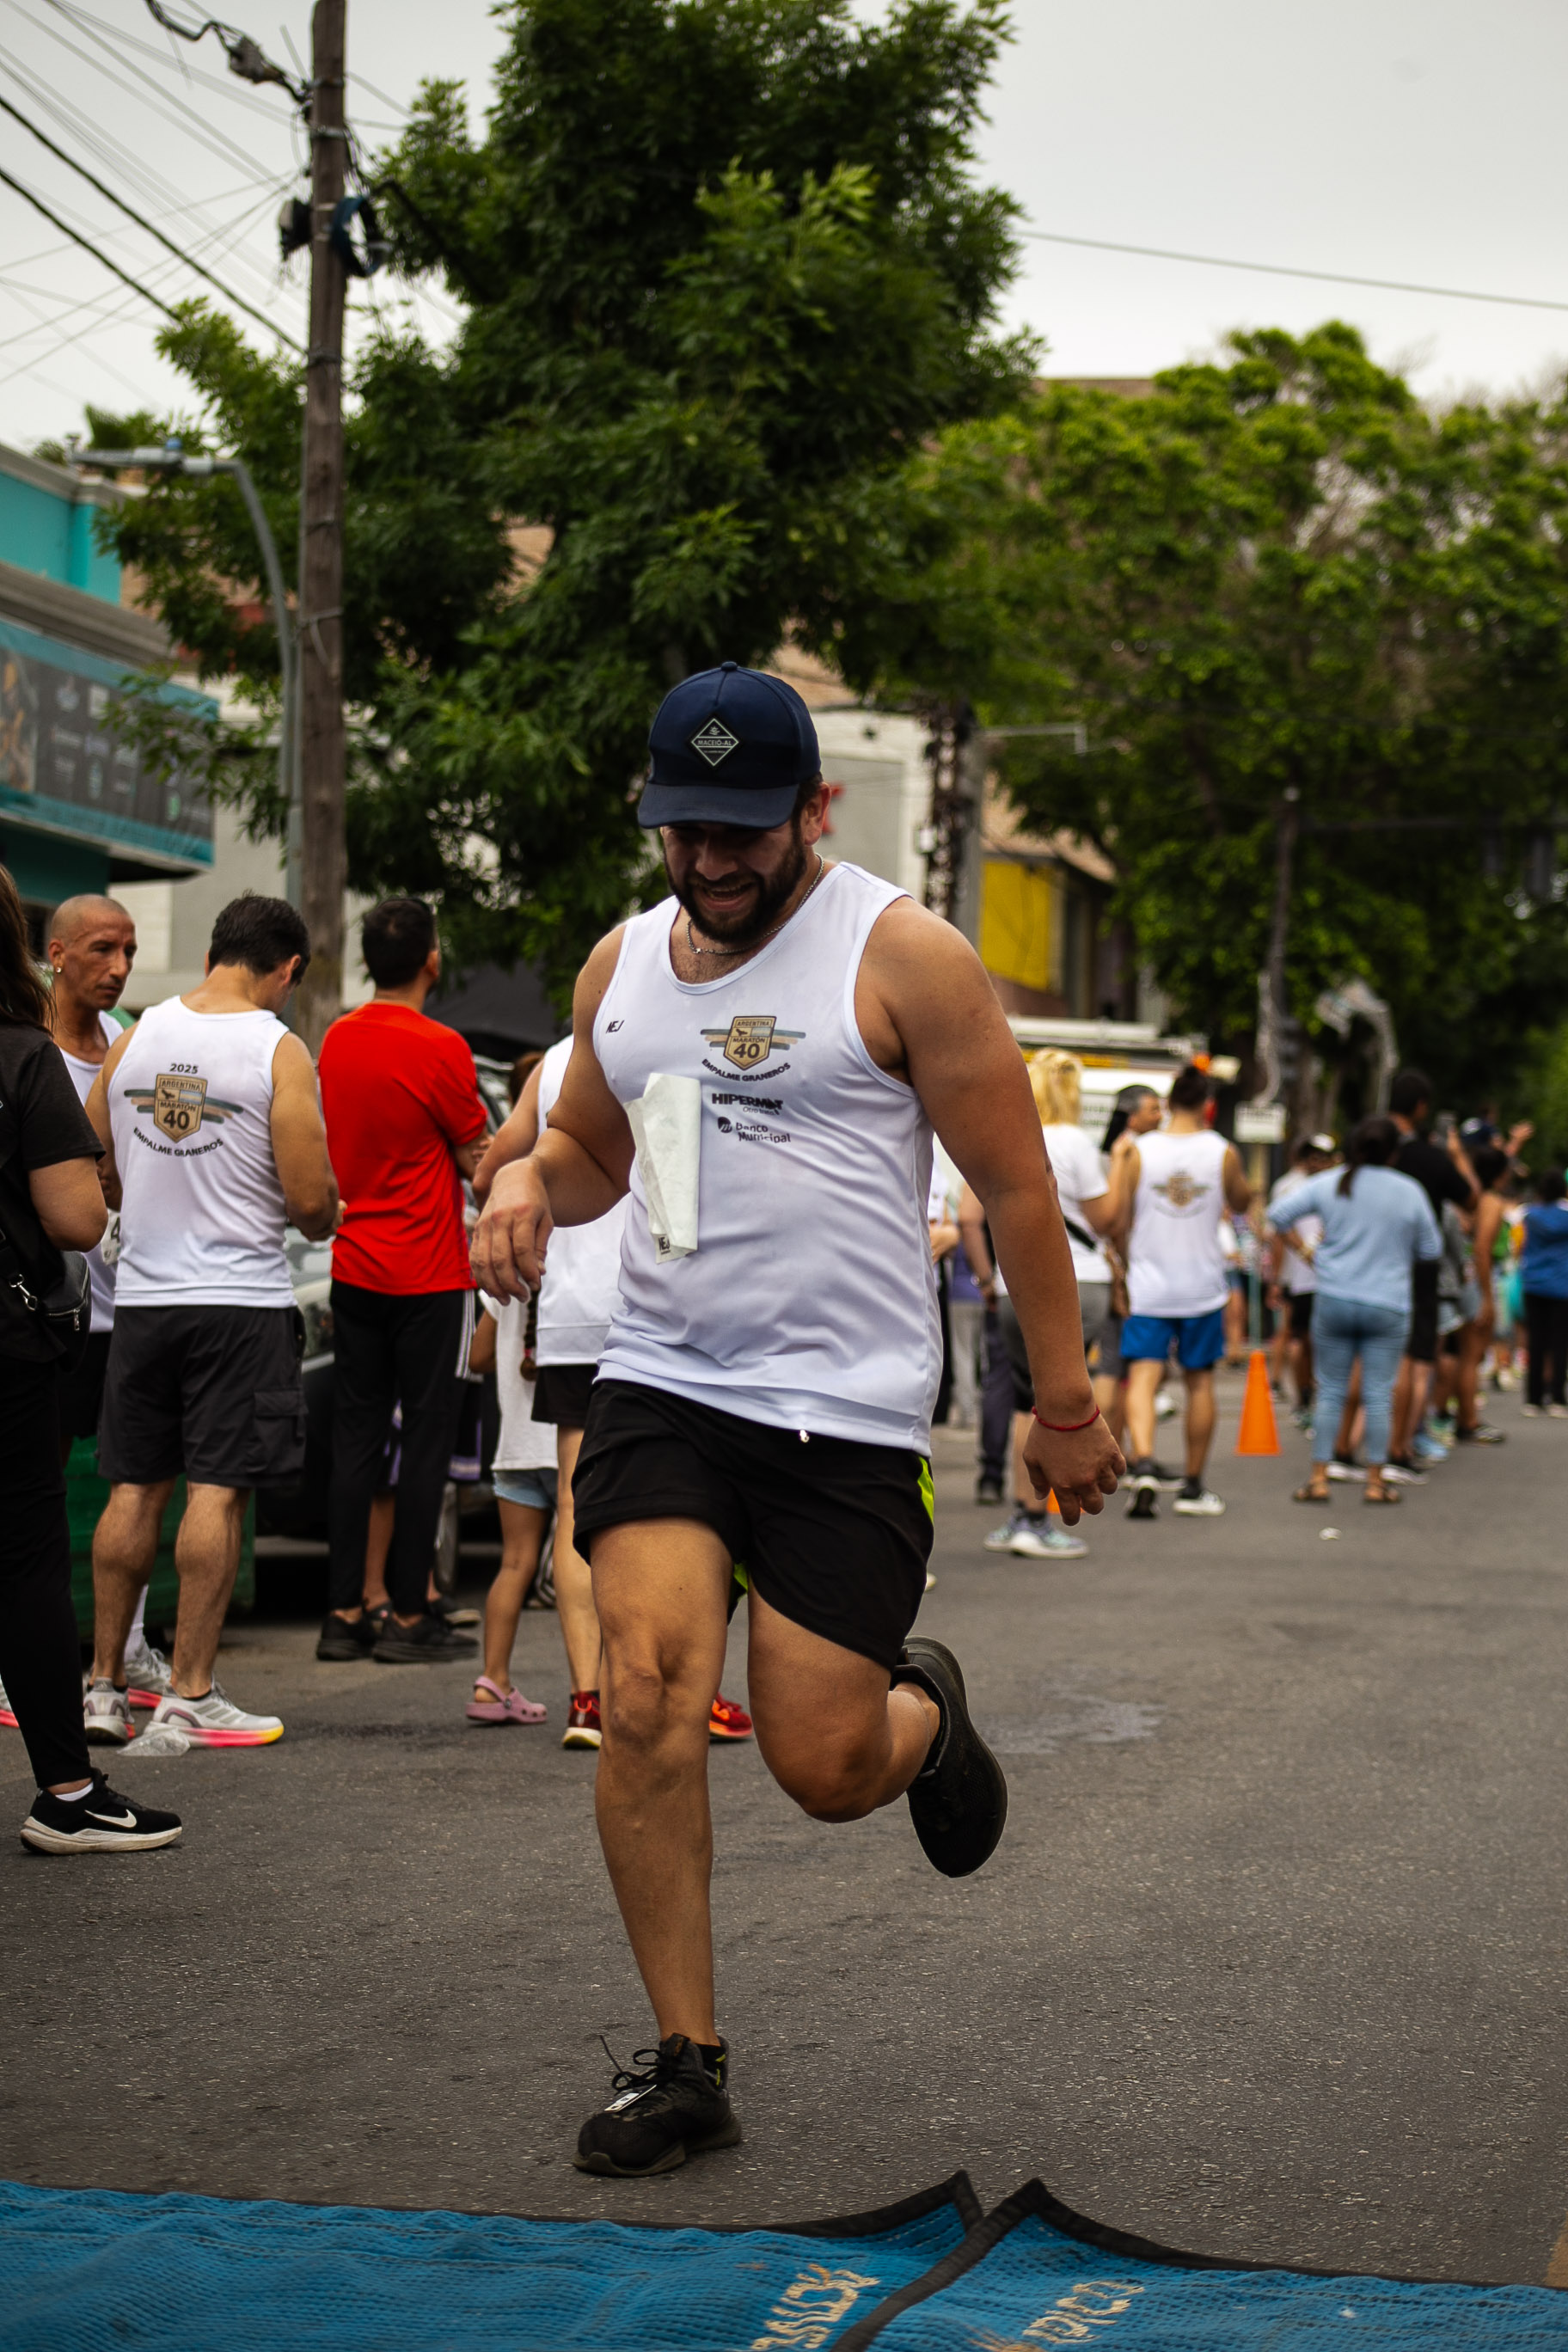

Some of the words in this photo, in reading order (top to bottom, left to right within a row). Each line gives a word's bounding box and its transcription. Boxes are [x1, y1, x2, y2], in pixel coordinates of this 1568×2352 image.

[733, 1043, 761, 1059] 40
[169, 1063, 199, 1074] 2025
[701, 1058, 741, 1081] EMPALME
[742, 1062, 791, 1082] GRANEROS
[161, 1080, 200, 1091] ARGENTINA
[160, 1101, 196, 1112] MARATÓN
[163, 1110, 190, 1130] 40
[736, 1122, 769, 1132] Banco
[133, 1126, 172, 1155] EMPALME
[738, 1131, 791, 1143] Municipal
